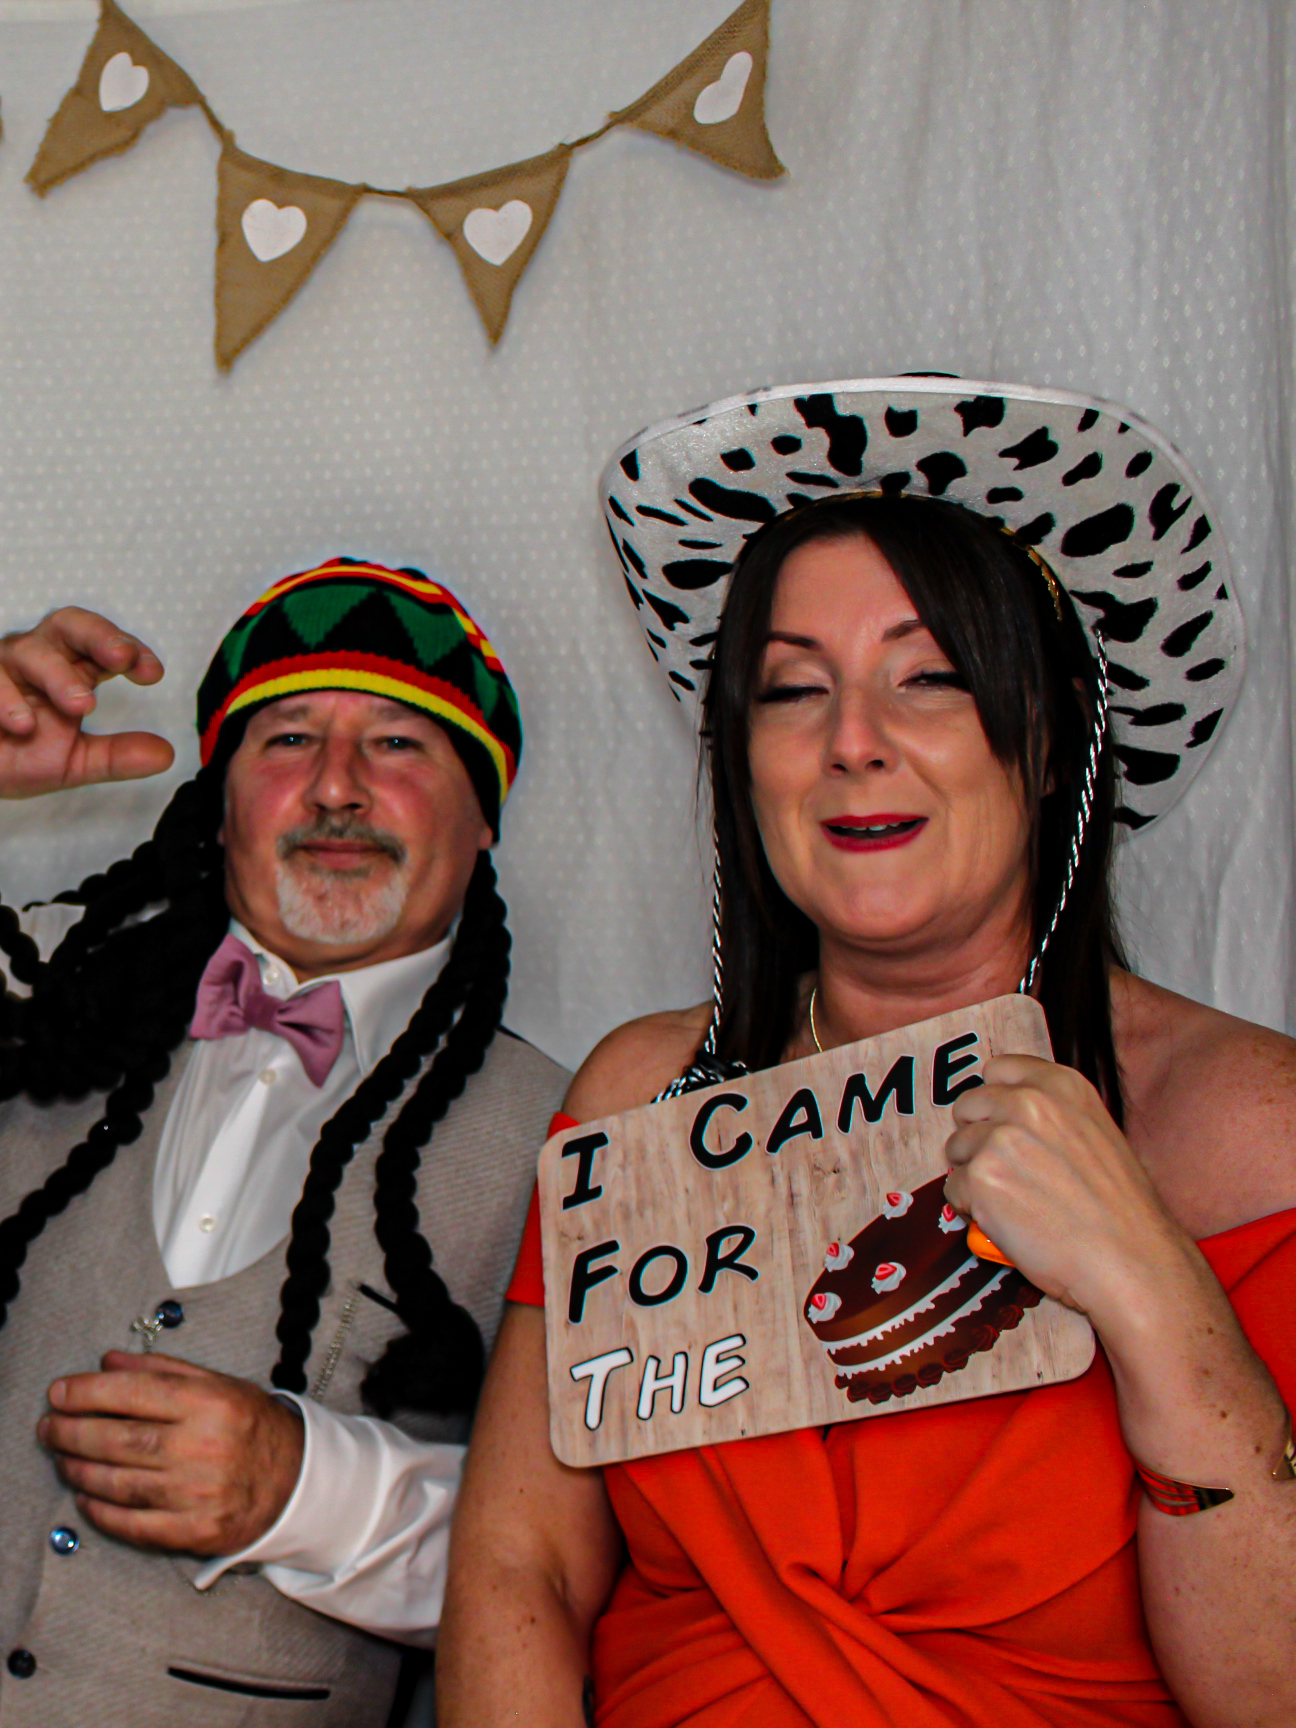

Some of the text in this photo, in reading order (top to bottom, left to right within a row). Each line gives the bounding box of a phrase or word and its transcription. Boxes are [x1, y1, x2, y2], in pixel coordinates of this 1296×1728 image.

[562, 1032, 984, 1210] I CAME
[568, 1225, 759, 1324] FOR
[570, 1334, 750, 1431] THE
